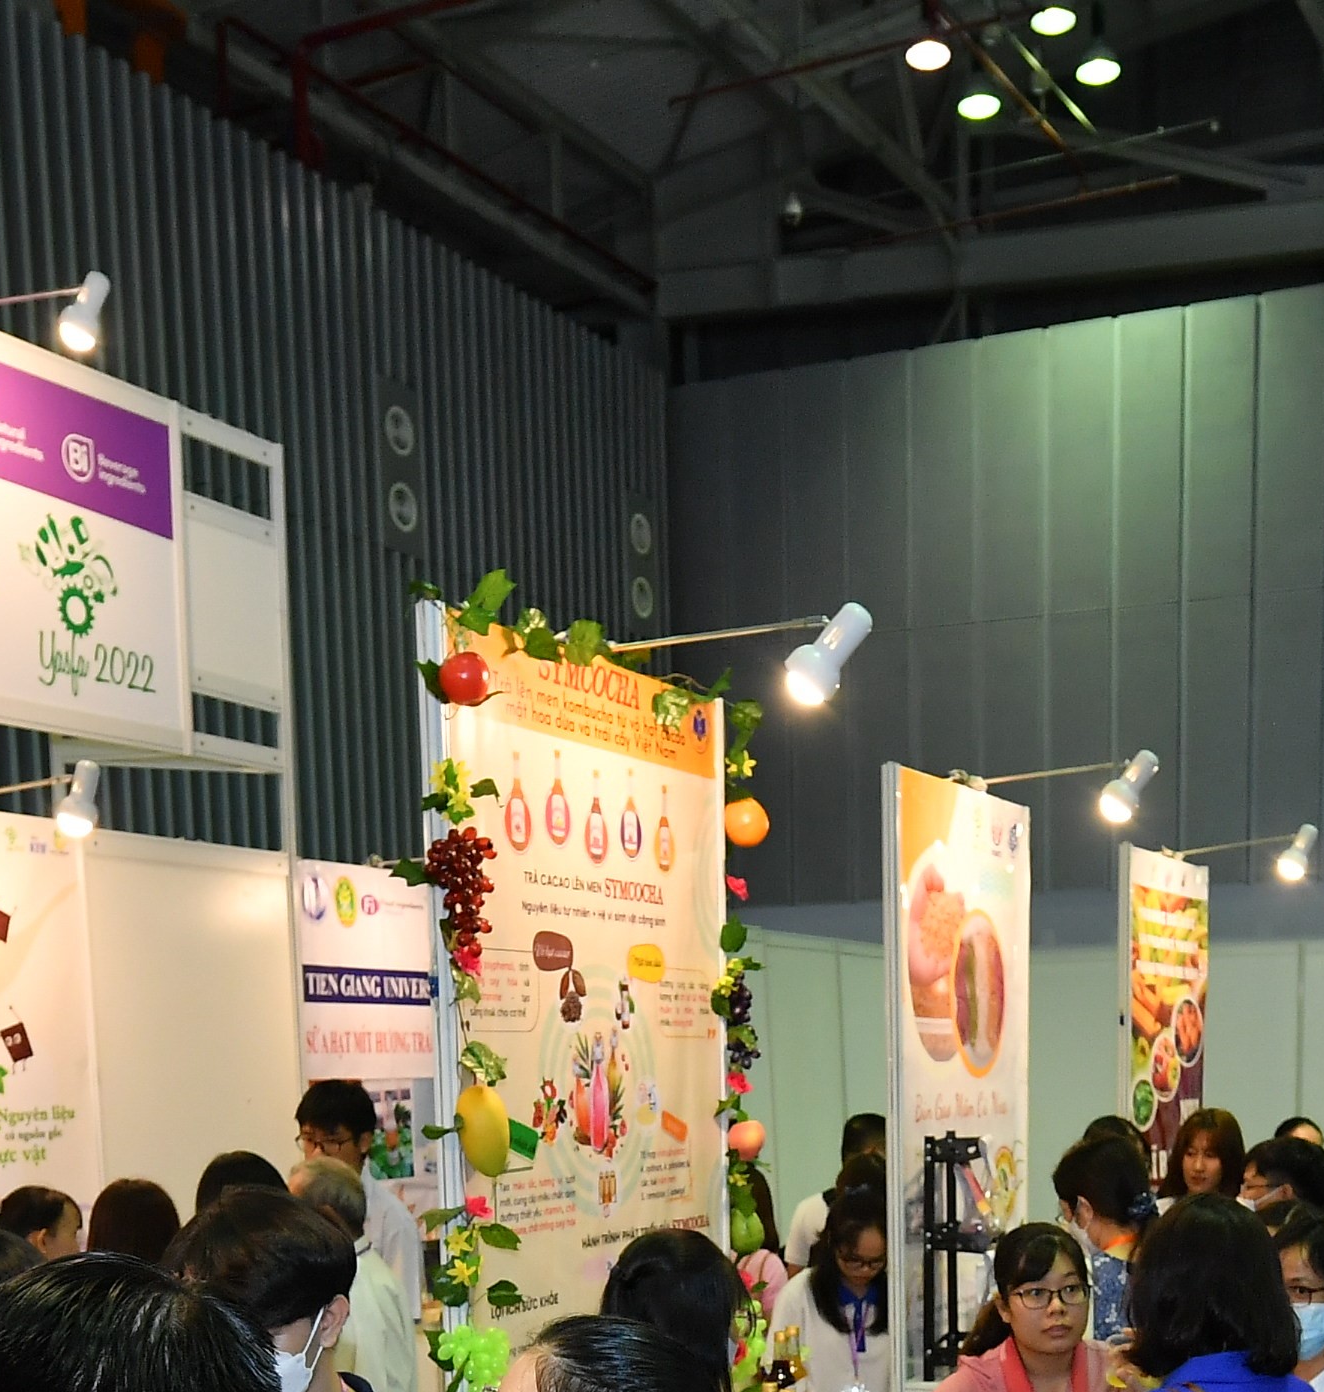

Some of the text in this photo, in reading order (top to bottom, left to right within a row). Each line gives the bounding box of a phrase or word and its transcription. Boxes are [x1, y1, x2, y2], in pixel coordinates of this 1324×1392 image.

[94, 644, 156, 694] 2022
[532, 706, 552, 727] hoa
[536, 690, 559, 709] men
[563, 690, 614, 725] kombucha
[541, 873, 570, 889] CACAO
[587, 881, 602, 894] MEN
[604, 877, 664, 906] SYMCOCHA
[306, 971, 338, 996] TIEN
[340, 973, 381, 998] GIANG
[52, 1105, 75, 1123] liệu
[23, 1145, 46, 1166] vật
